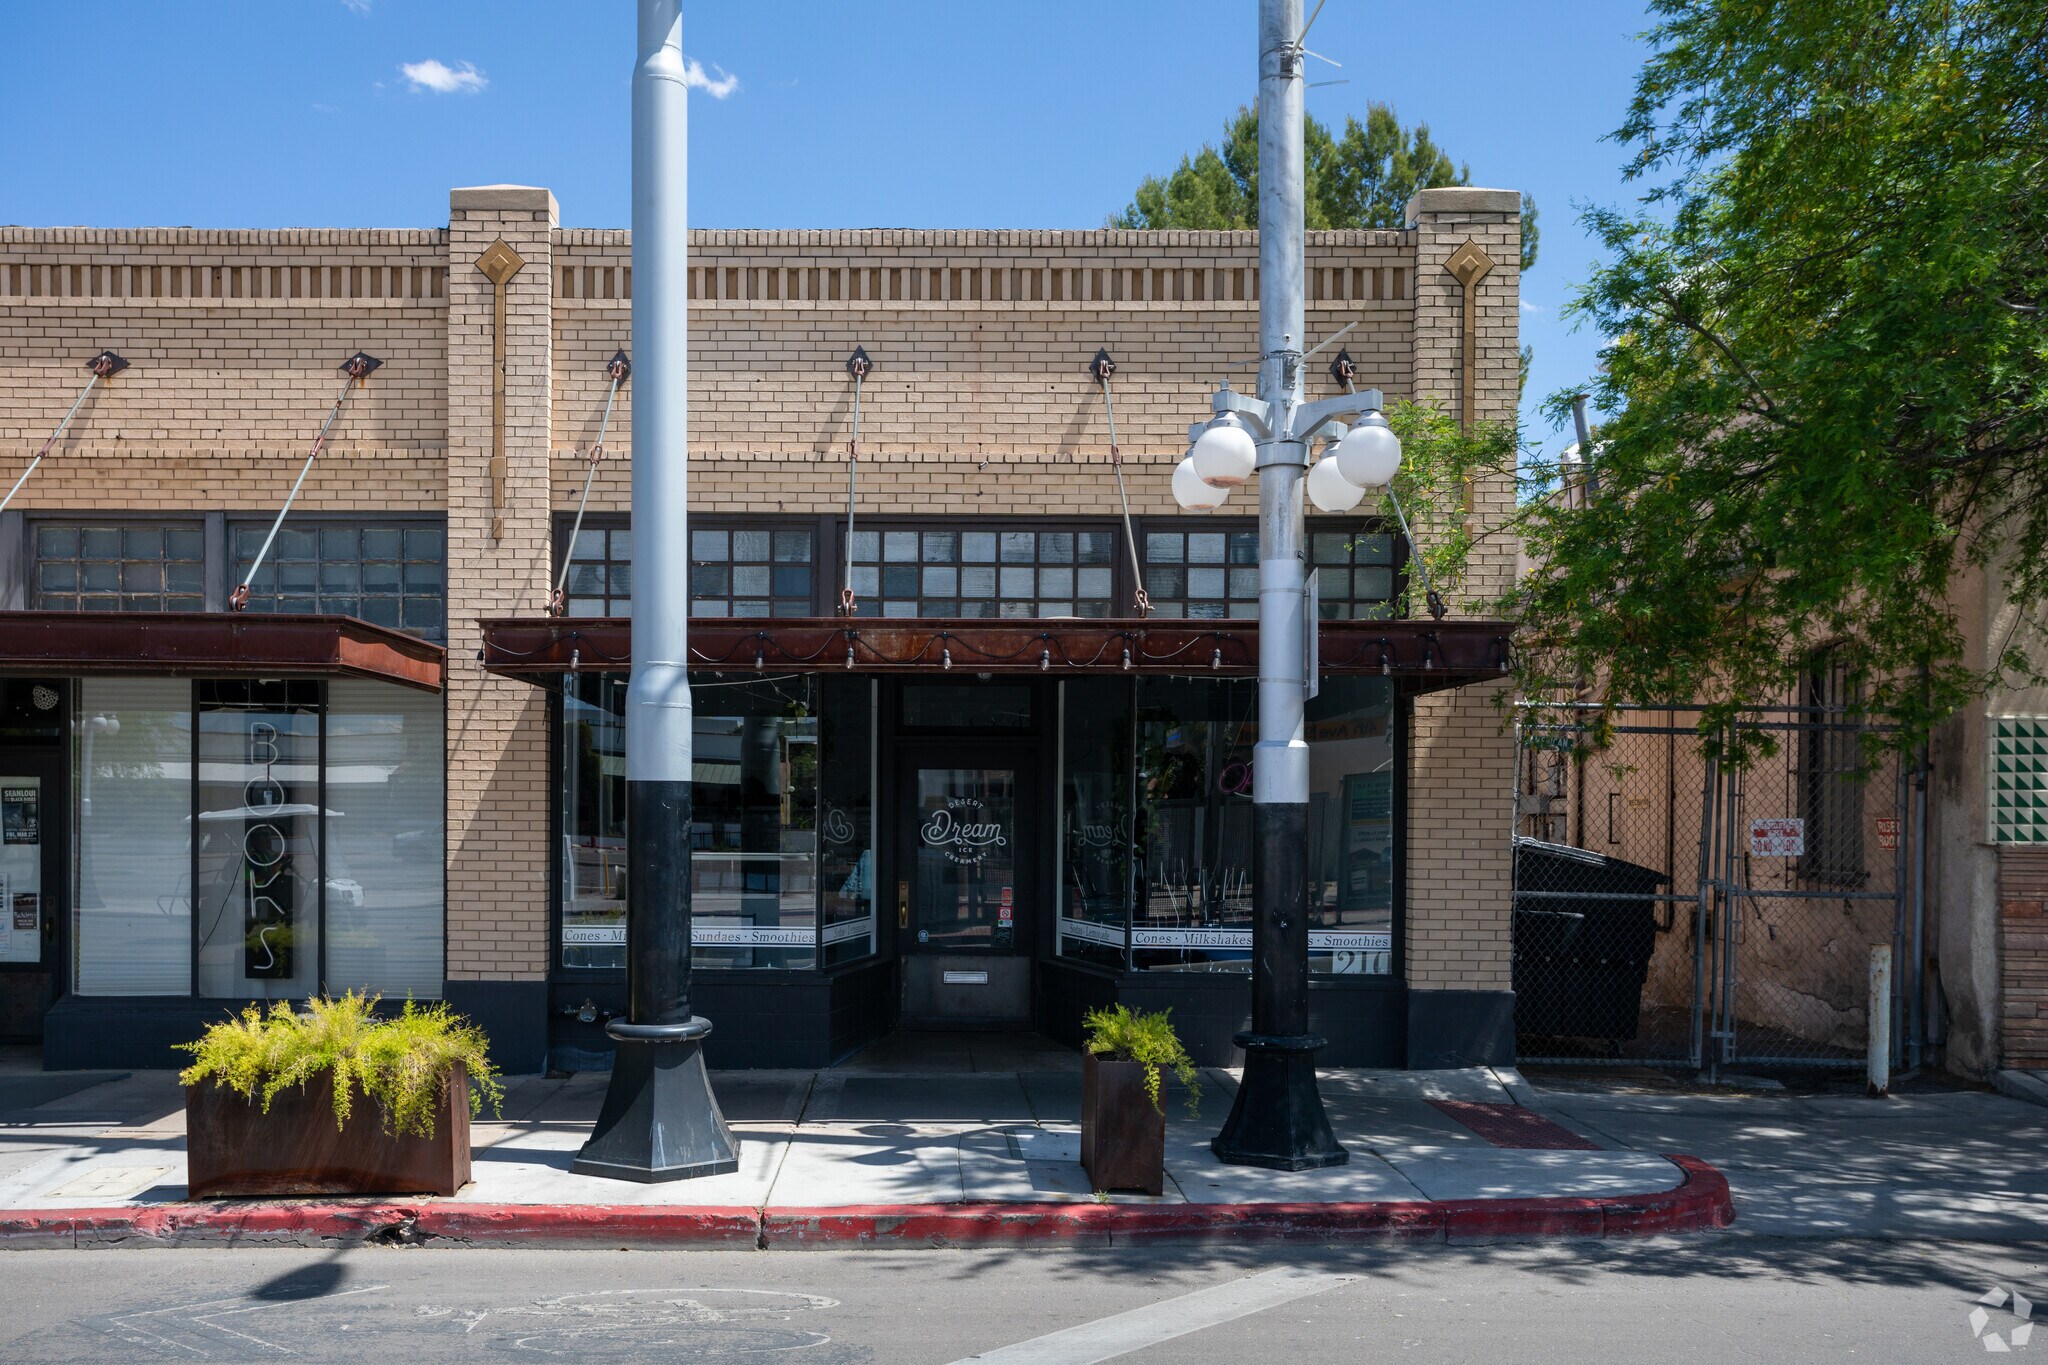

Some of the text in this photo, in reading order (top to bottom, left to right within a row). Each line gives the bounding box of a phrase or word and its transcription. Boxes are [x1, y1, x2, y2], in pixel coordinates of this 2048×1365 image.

[948, 798, 984, 809] DESERT
[920, 809, 1007, 846] Dream
[244, 722, 285, 970] BOOKS
[944, 851, 987, 864] CREAMERY
[564, 929, 600, 941] Cones
[691, 930, 815, 943] Sundaes Smoothies
[1135, 932, 1252, 945] Cones Milkshakes
[1324, 935, 1388, 947] Smoothies
